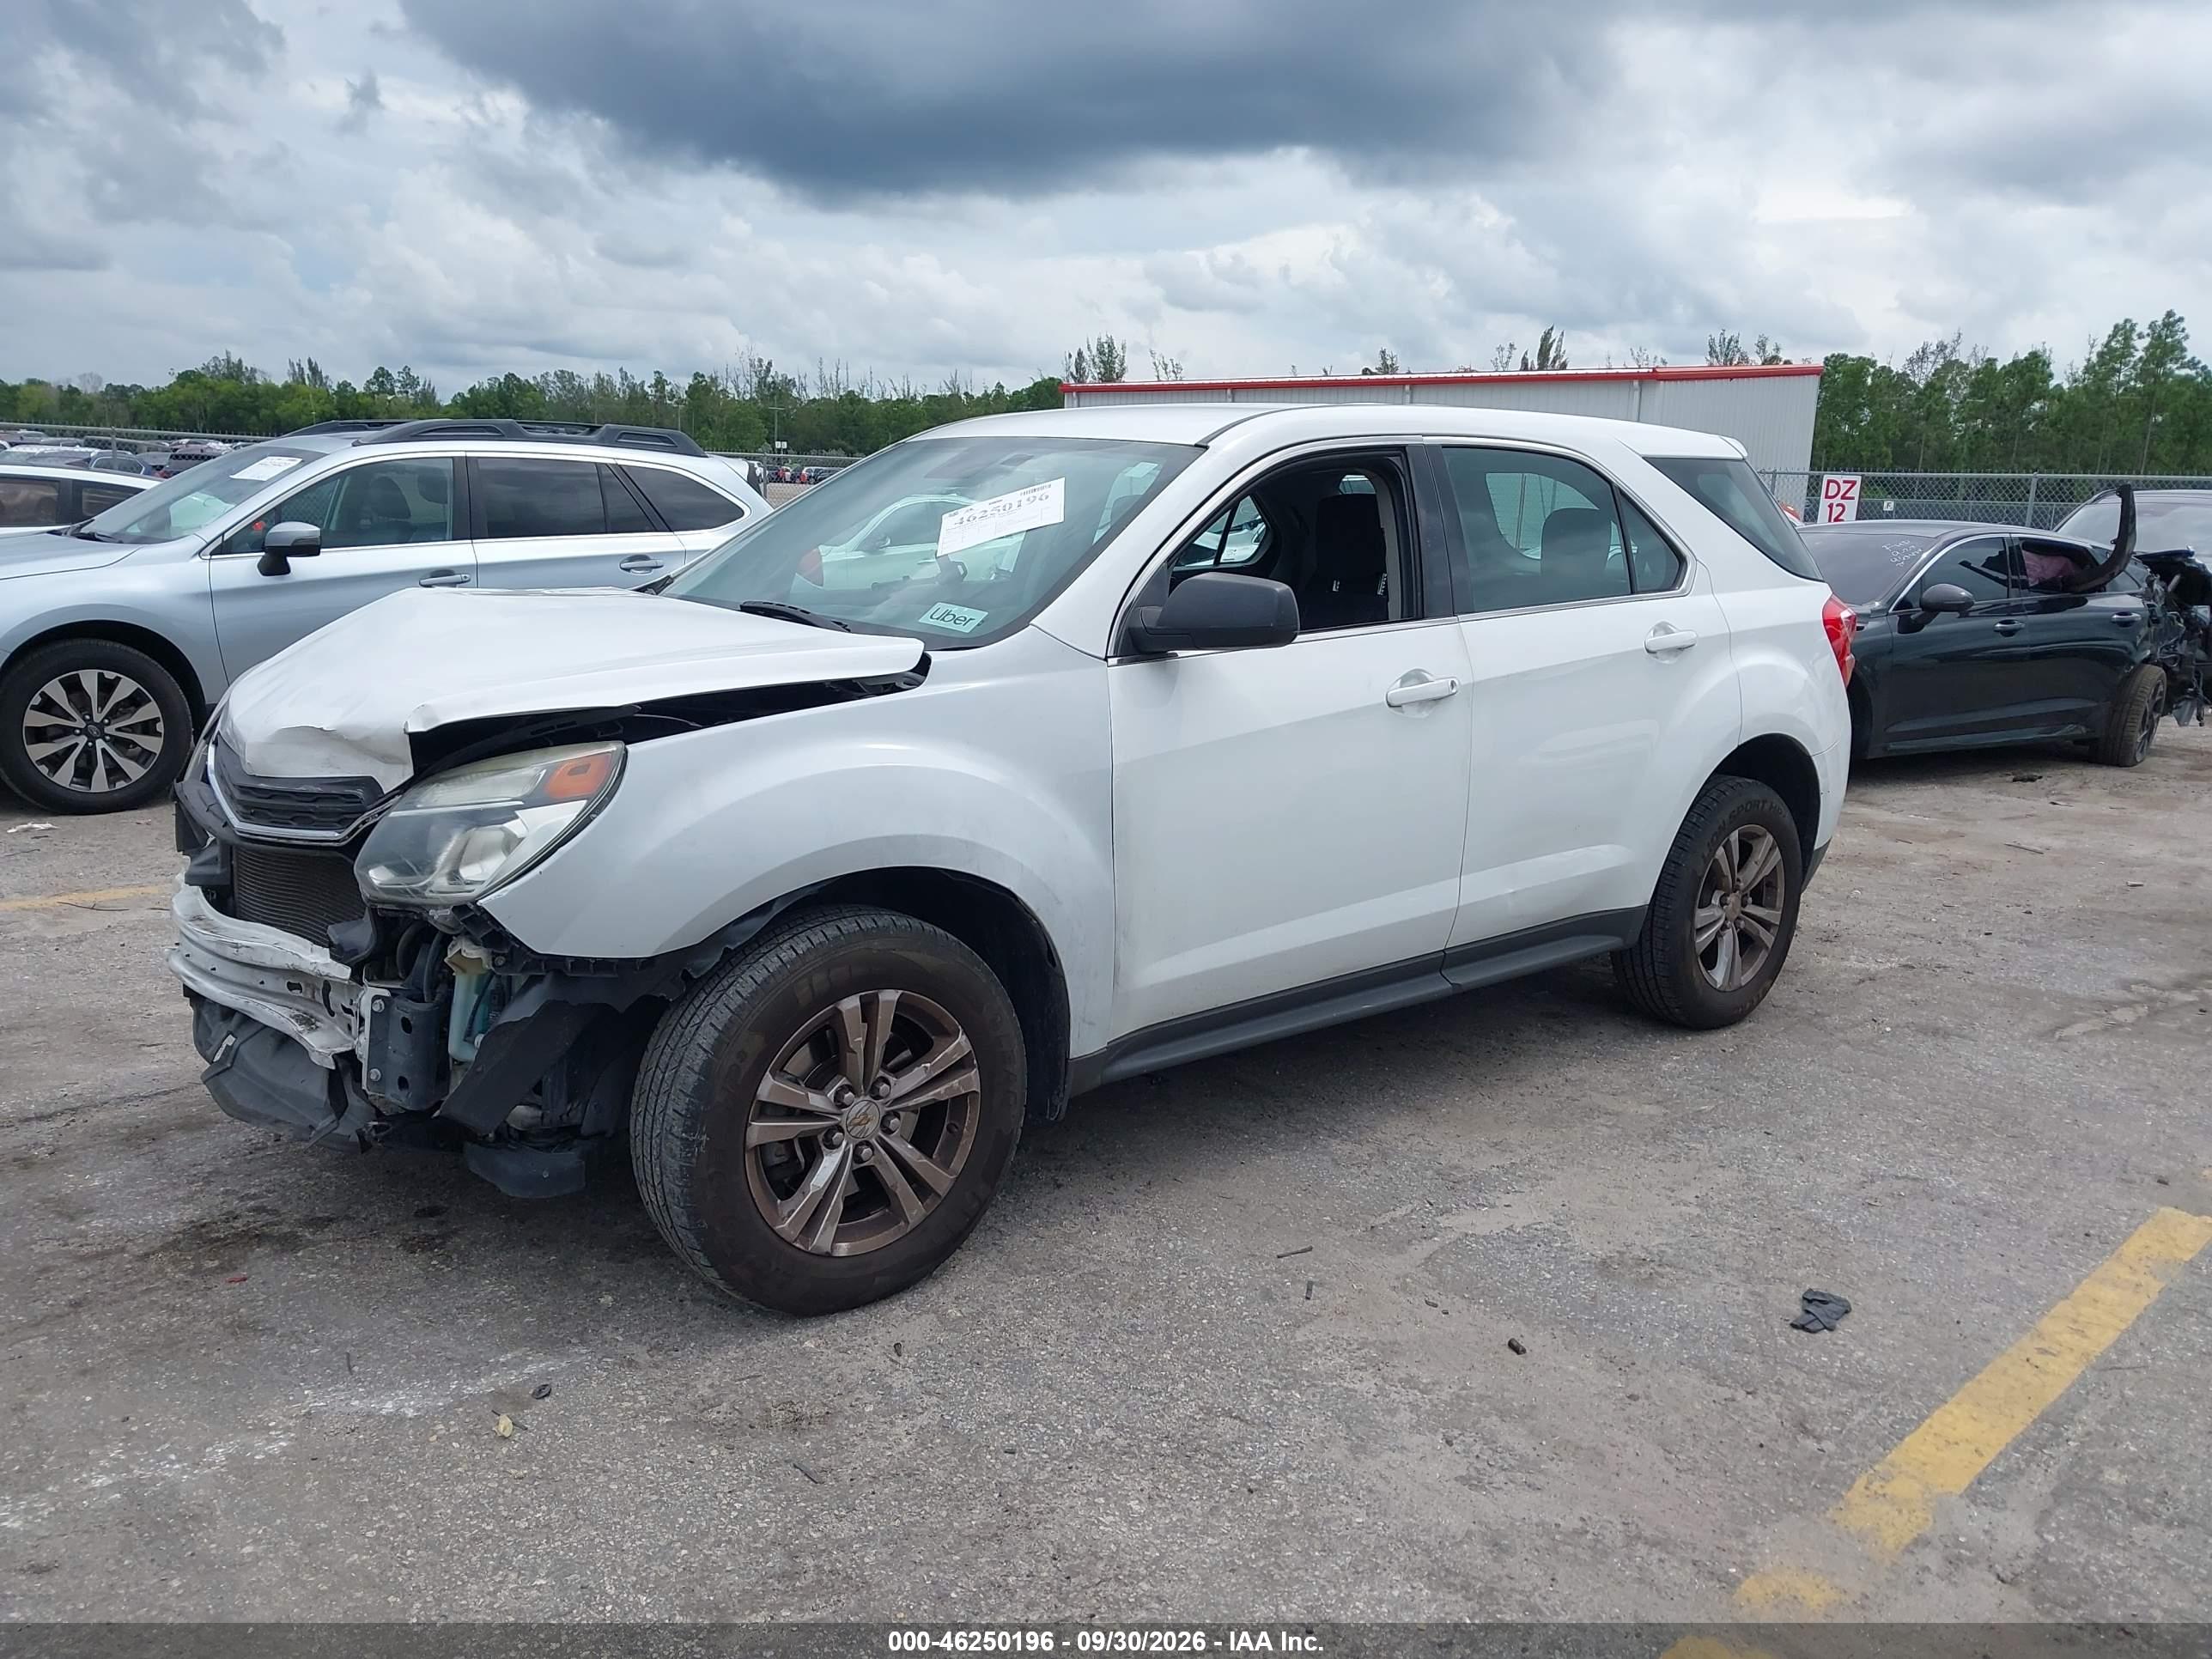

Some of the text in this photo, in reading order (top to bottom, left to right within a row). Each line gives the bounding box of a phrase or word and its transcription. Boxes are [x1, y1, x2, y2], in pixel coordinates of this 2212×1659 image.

[1824, 478, 1857, 501] DZ
[1827, 503, 1846, 523] 12
[929, 606, 975, 627] Uber
[1729, 799, 1766, 821] SPORT
